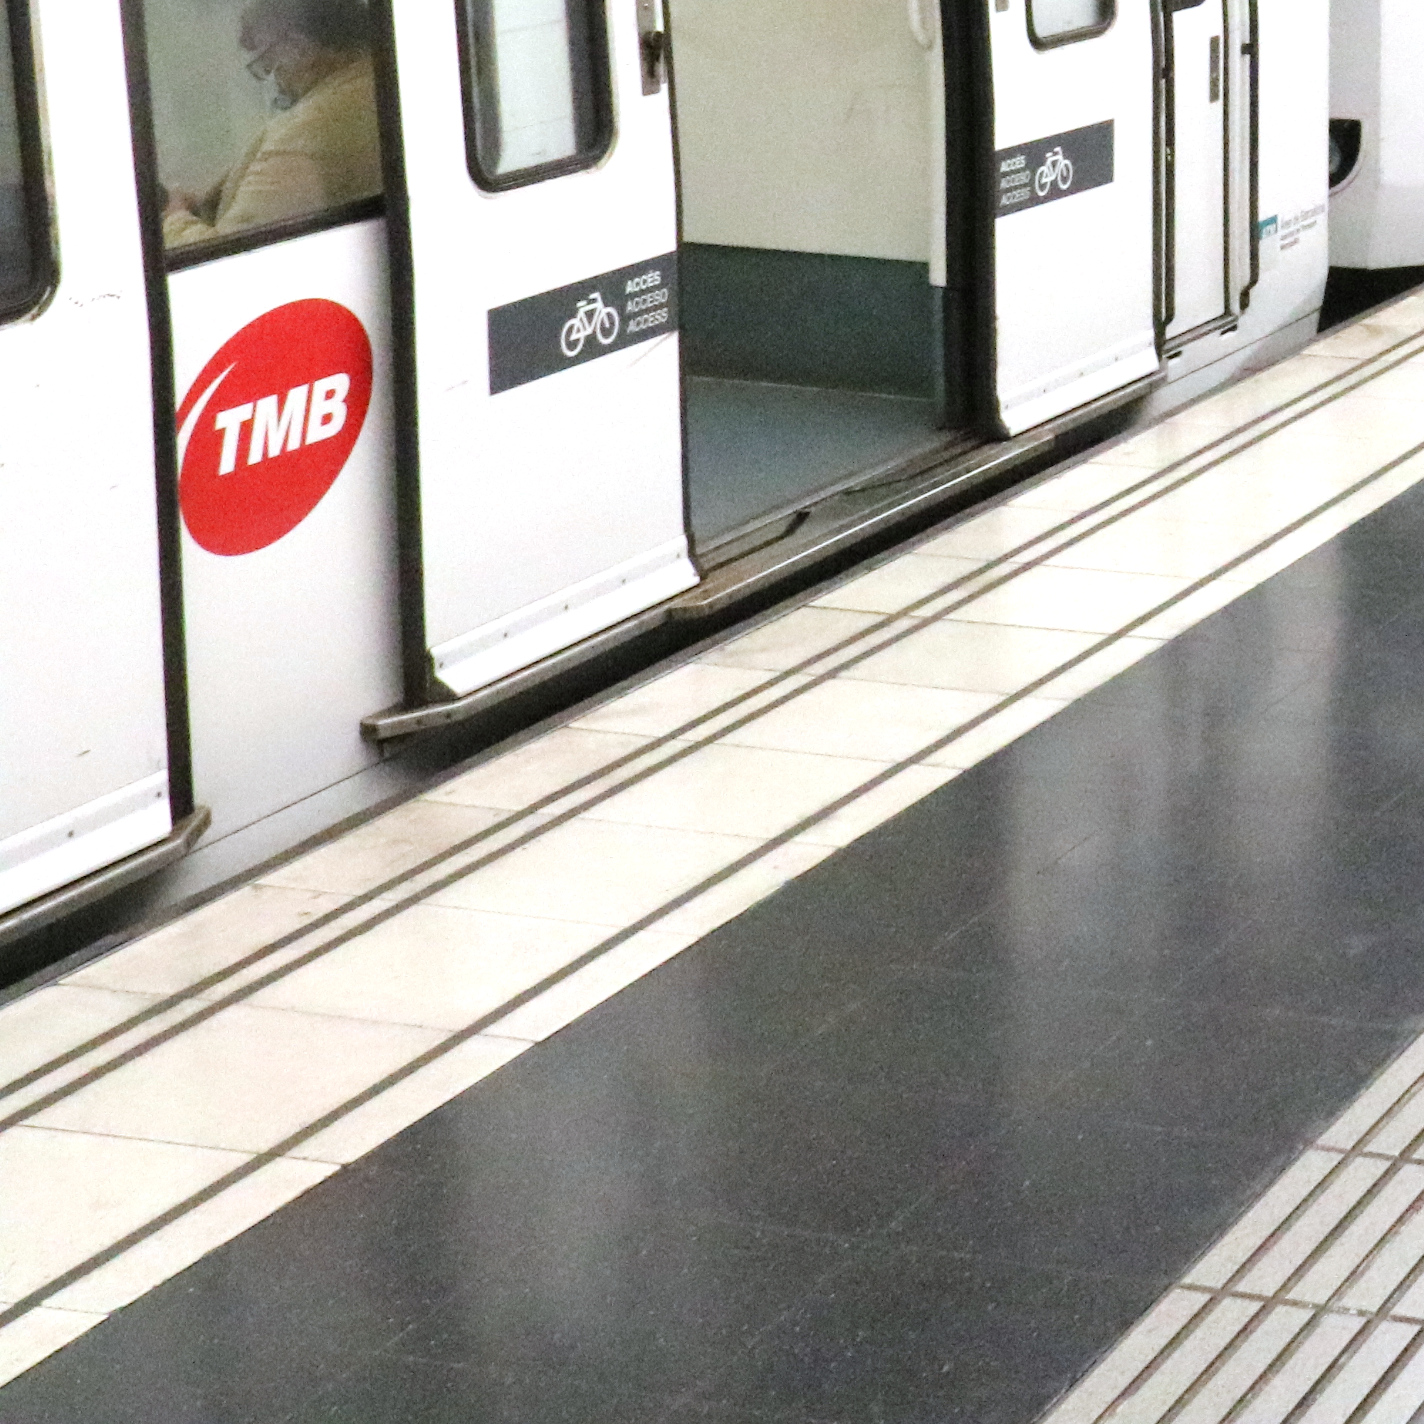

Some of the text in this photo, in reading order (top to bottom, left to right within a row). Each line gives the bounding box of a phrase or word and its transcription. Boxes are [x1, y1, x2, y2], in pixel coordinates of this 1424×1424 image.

[626, 288, 668, 314] ACCESO
[627, 307, 669, 333] ACCESS
[214, 372, 351, 477] TMB
